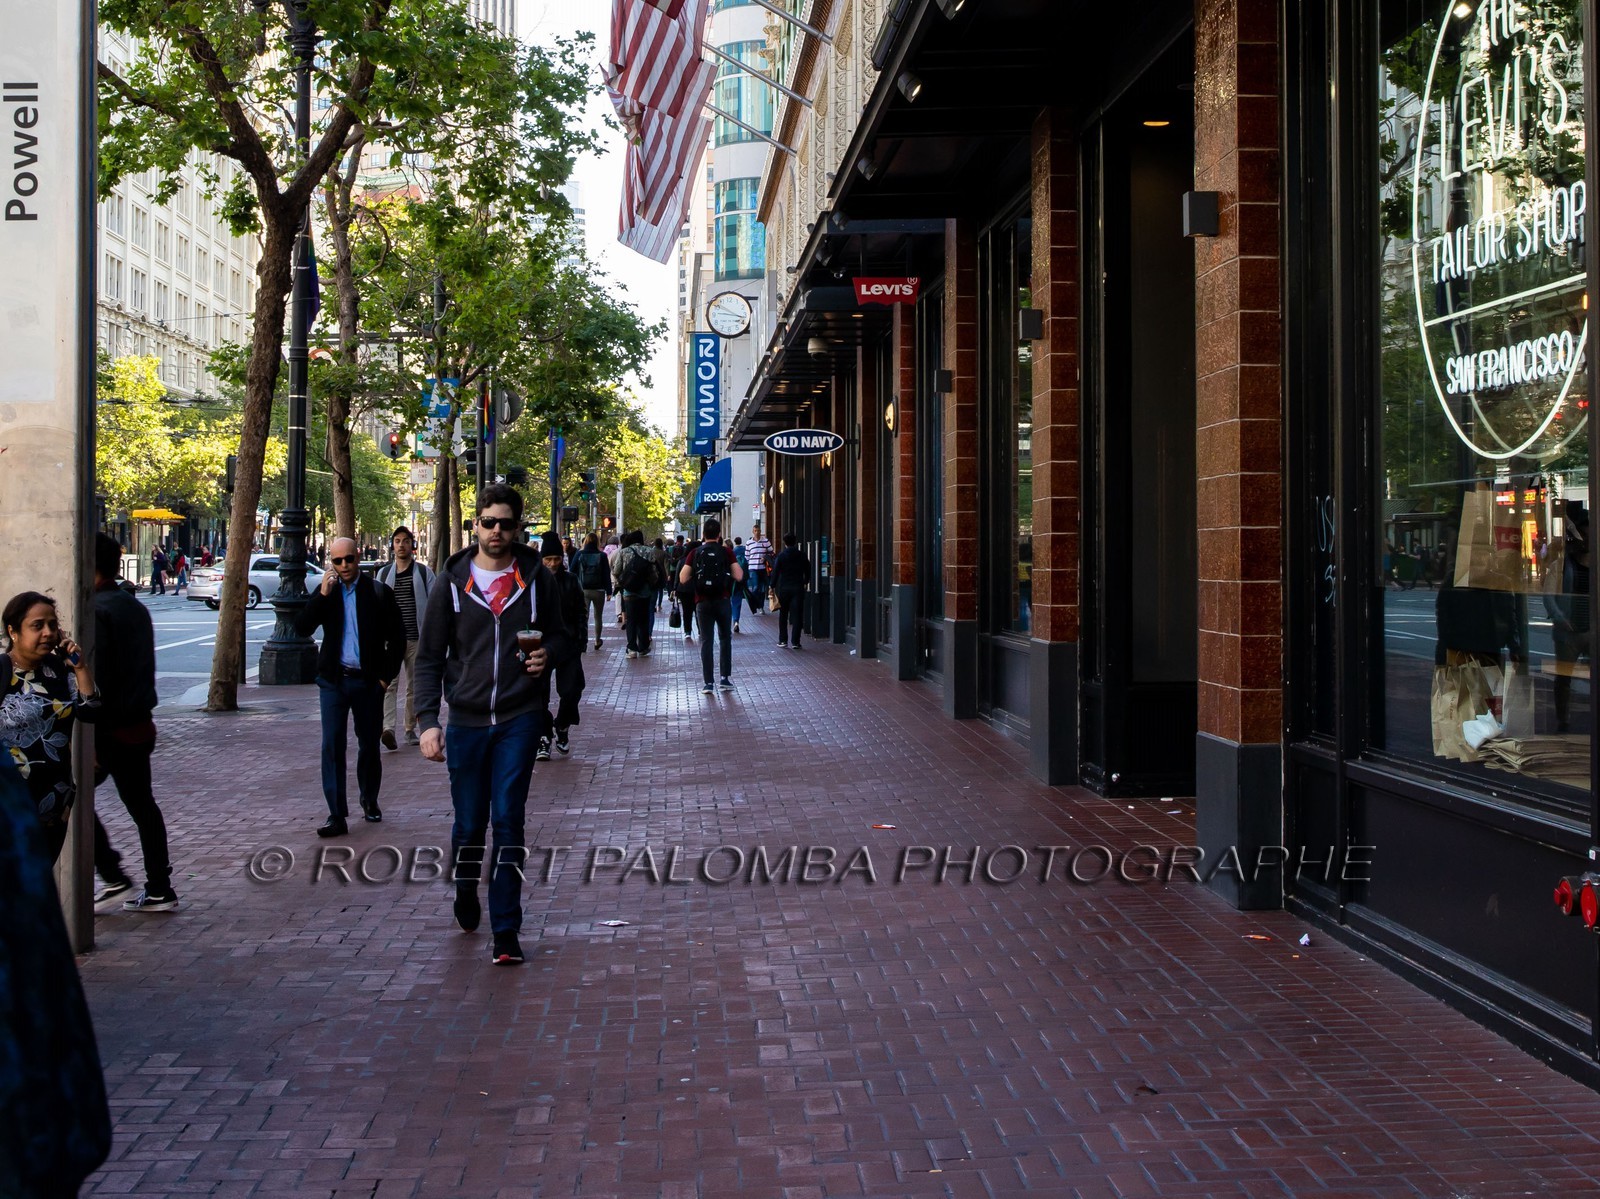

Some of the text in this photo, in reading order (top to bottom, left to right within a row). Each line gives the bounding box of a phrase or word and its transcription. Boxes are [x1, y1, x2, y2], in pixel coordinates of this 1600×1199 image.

[1440, 32, 1569, 182] LEVI'S
[2, 82, 39, 221] Powell
[1431, 180, 1587, 284] TAILOR SHOP
[861, 284, 914, 296] Levi's
[697, 338, 717, 427] ROSS
[1446, 330, 1573, 395] SAN FRANCISCO
[773, 436, 835, 449] OLD NAVY
[703, 492, 732, 502] ROSS
